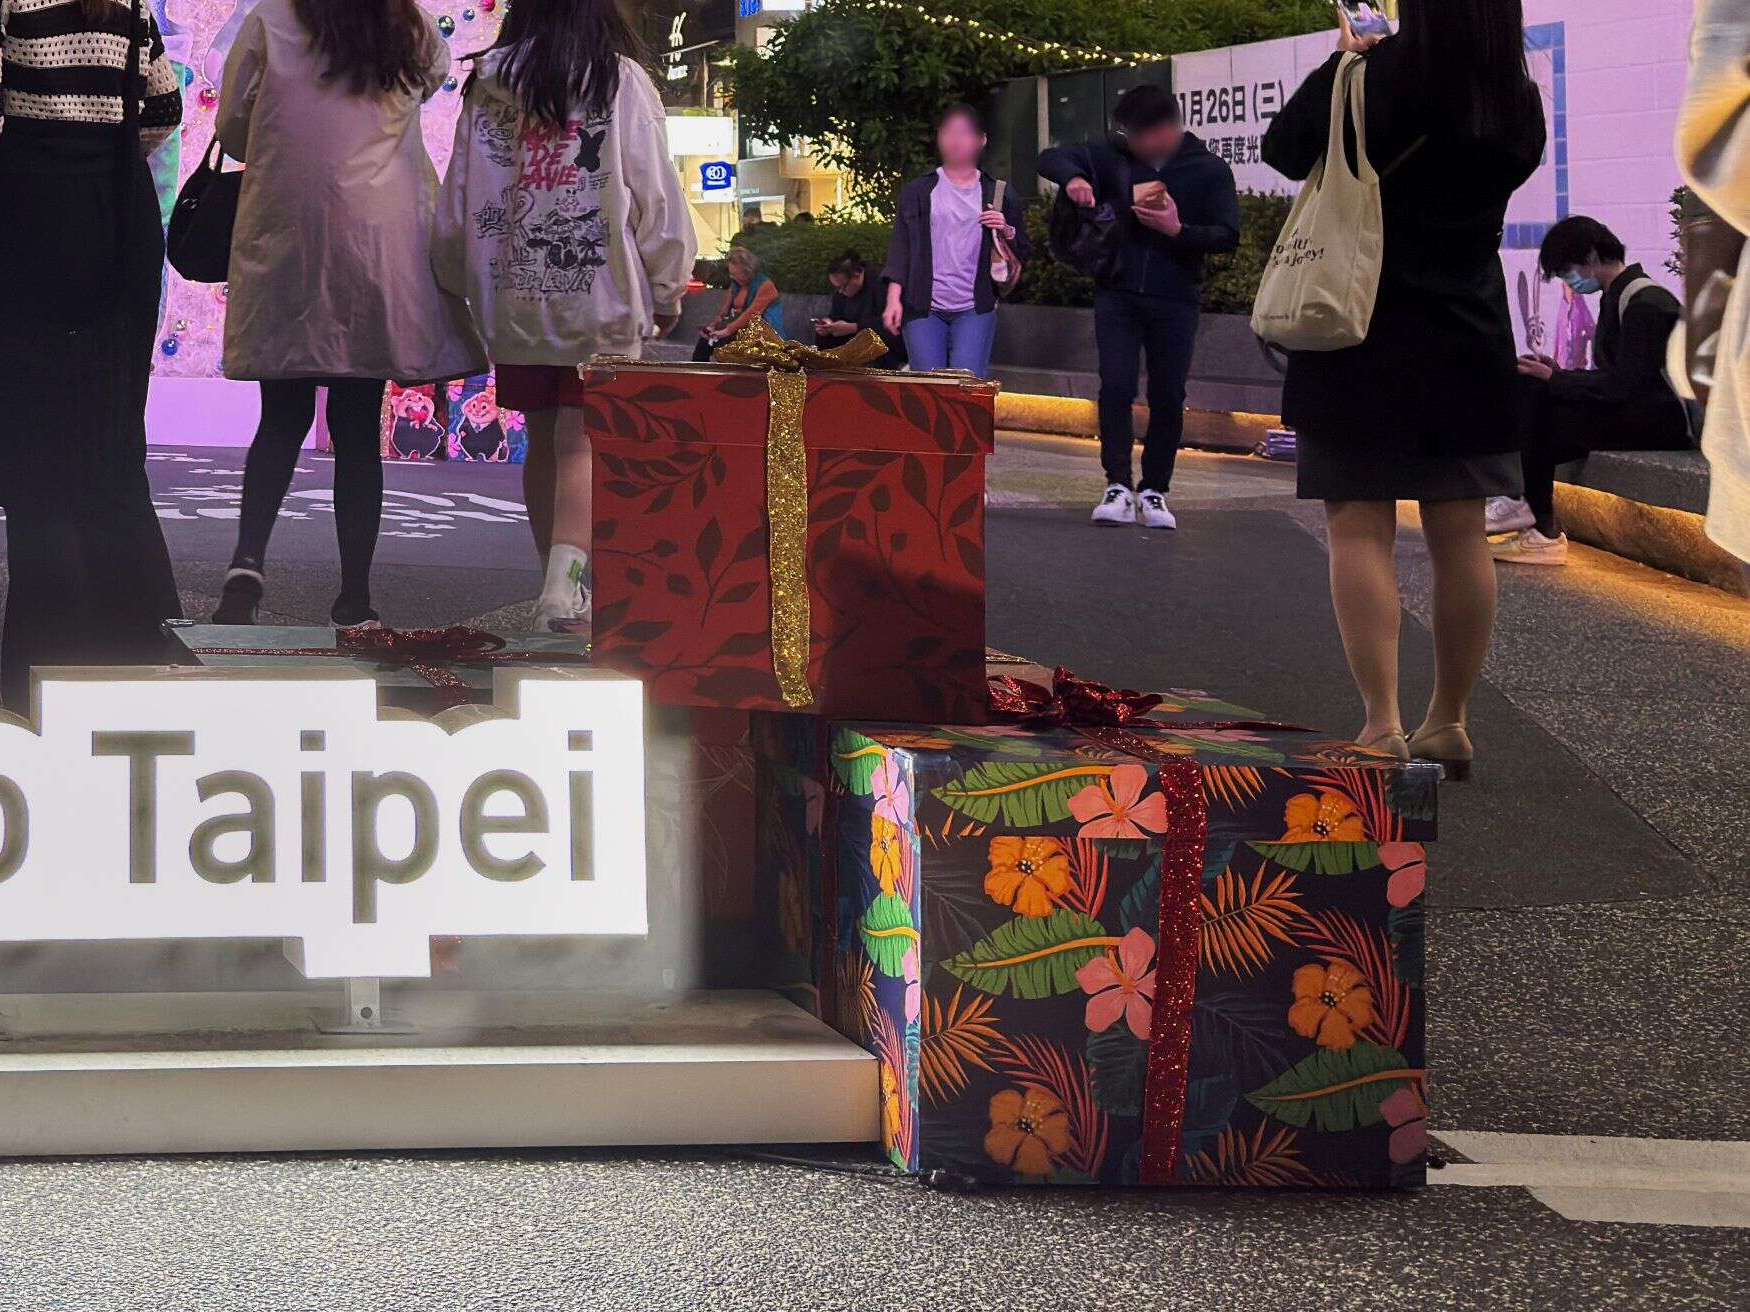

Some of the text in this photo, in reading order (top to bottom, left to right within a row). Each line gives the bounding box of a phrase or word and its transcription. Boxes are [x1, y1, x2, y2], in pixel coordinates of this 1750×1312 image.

[1179, 79, 1284, 127] 1月26日(三)
[1206, 135, 1263, 165] 您再度光
[91, 729, 596, 924] Taipei
